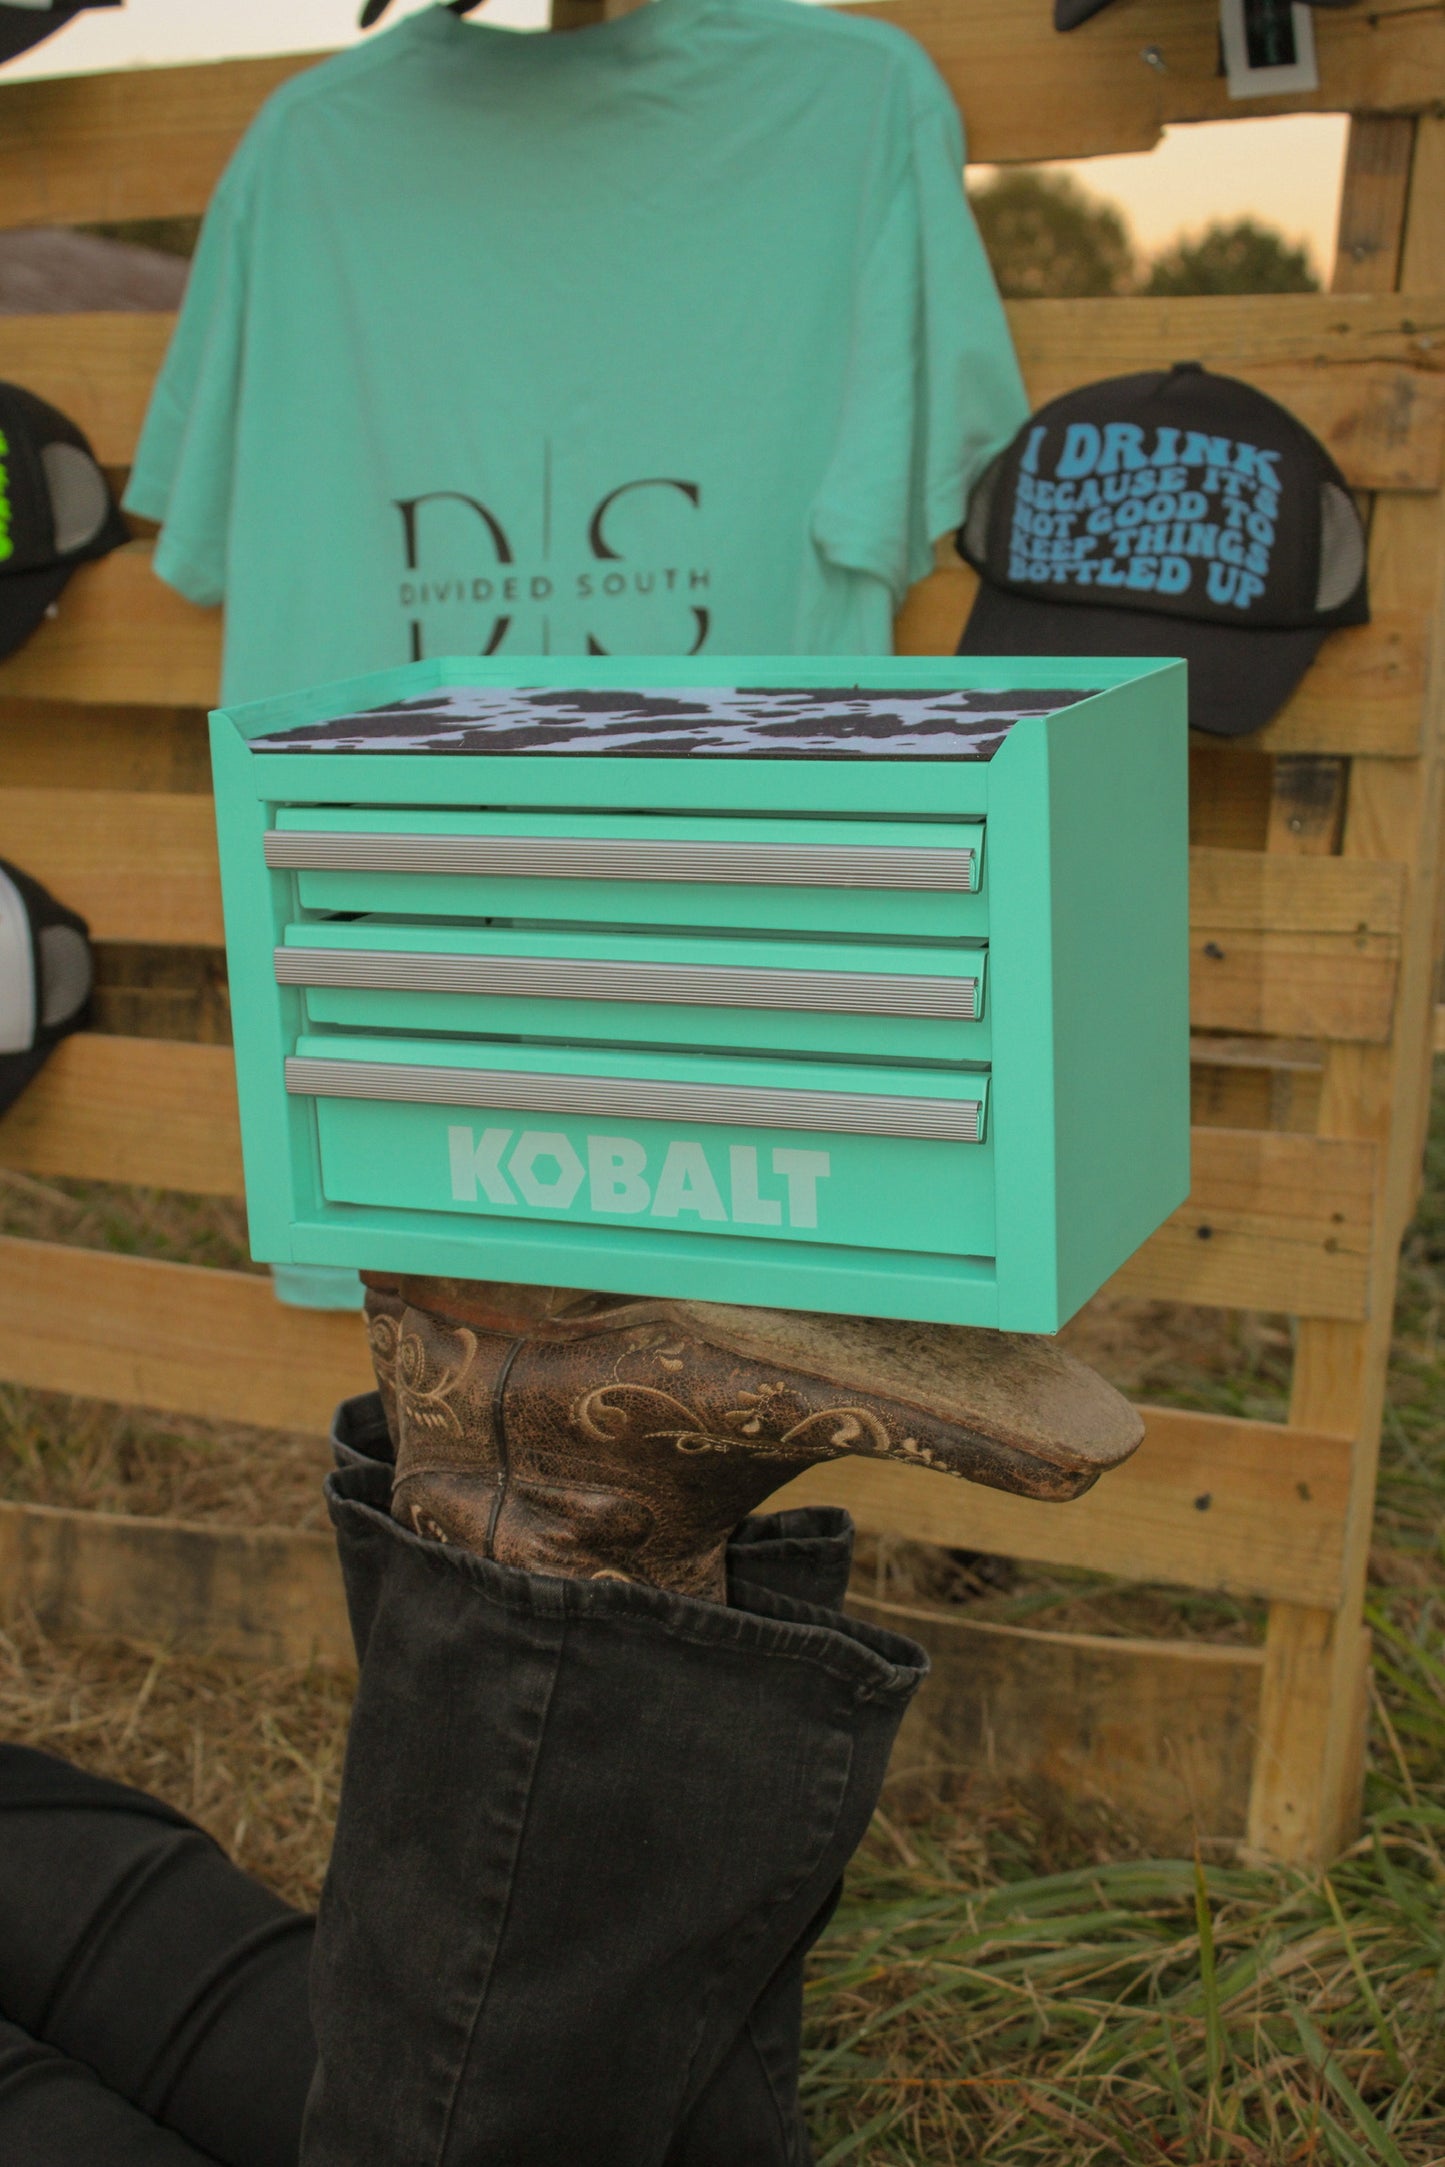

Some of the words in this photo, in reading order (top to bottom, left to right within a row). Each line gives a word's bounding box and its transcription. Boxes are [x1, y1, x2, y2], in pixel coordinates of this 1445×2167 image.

[1020, 426, 1047, 475] I
[1055, 422, 1282, 492] DRINK
[1012, 499, 1078, 539] NOT
[1085, 491, 1209, 536] GOOD
[1221, 499, 1276, 547] TO
[1016, 466, 1189, 512] BECAUSE
[1202, 466, 1279, 521] IT'S
[1009, 525, 1099, 563] KEEP
[1108, 522, 1270, 577] THINGS
[400, 576, 553, 606] DIVIDED
[577, 568, 711, 597] SOUTH
[1007, 555, 1193, 596] BOTTLED
[1206, 560, 1266, 609] UP
[448, 1125, 832, 1229] KOBALT
